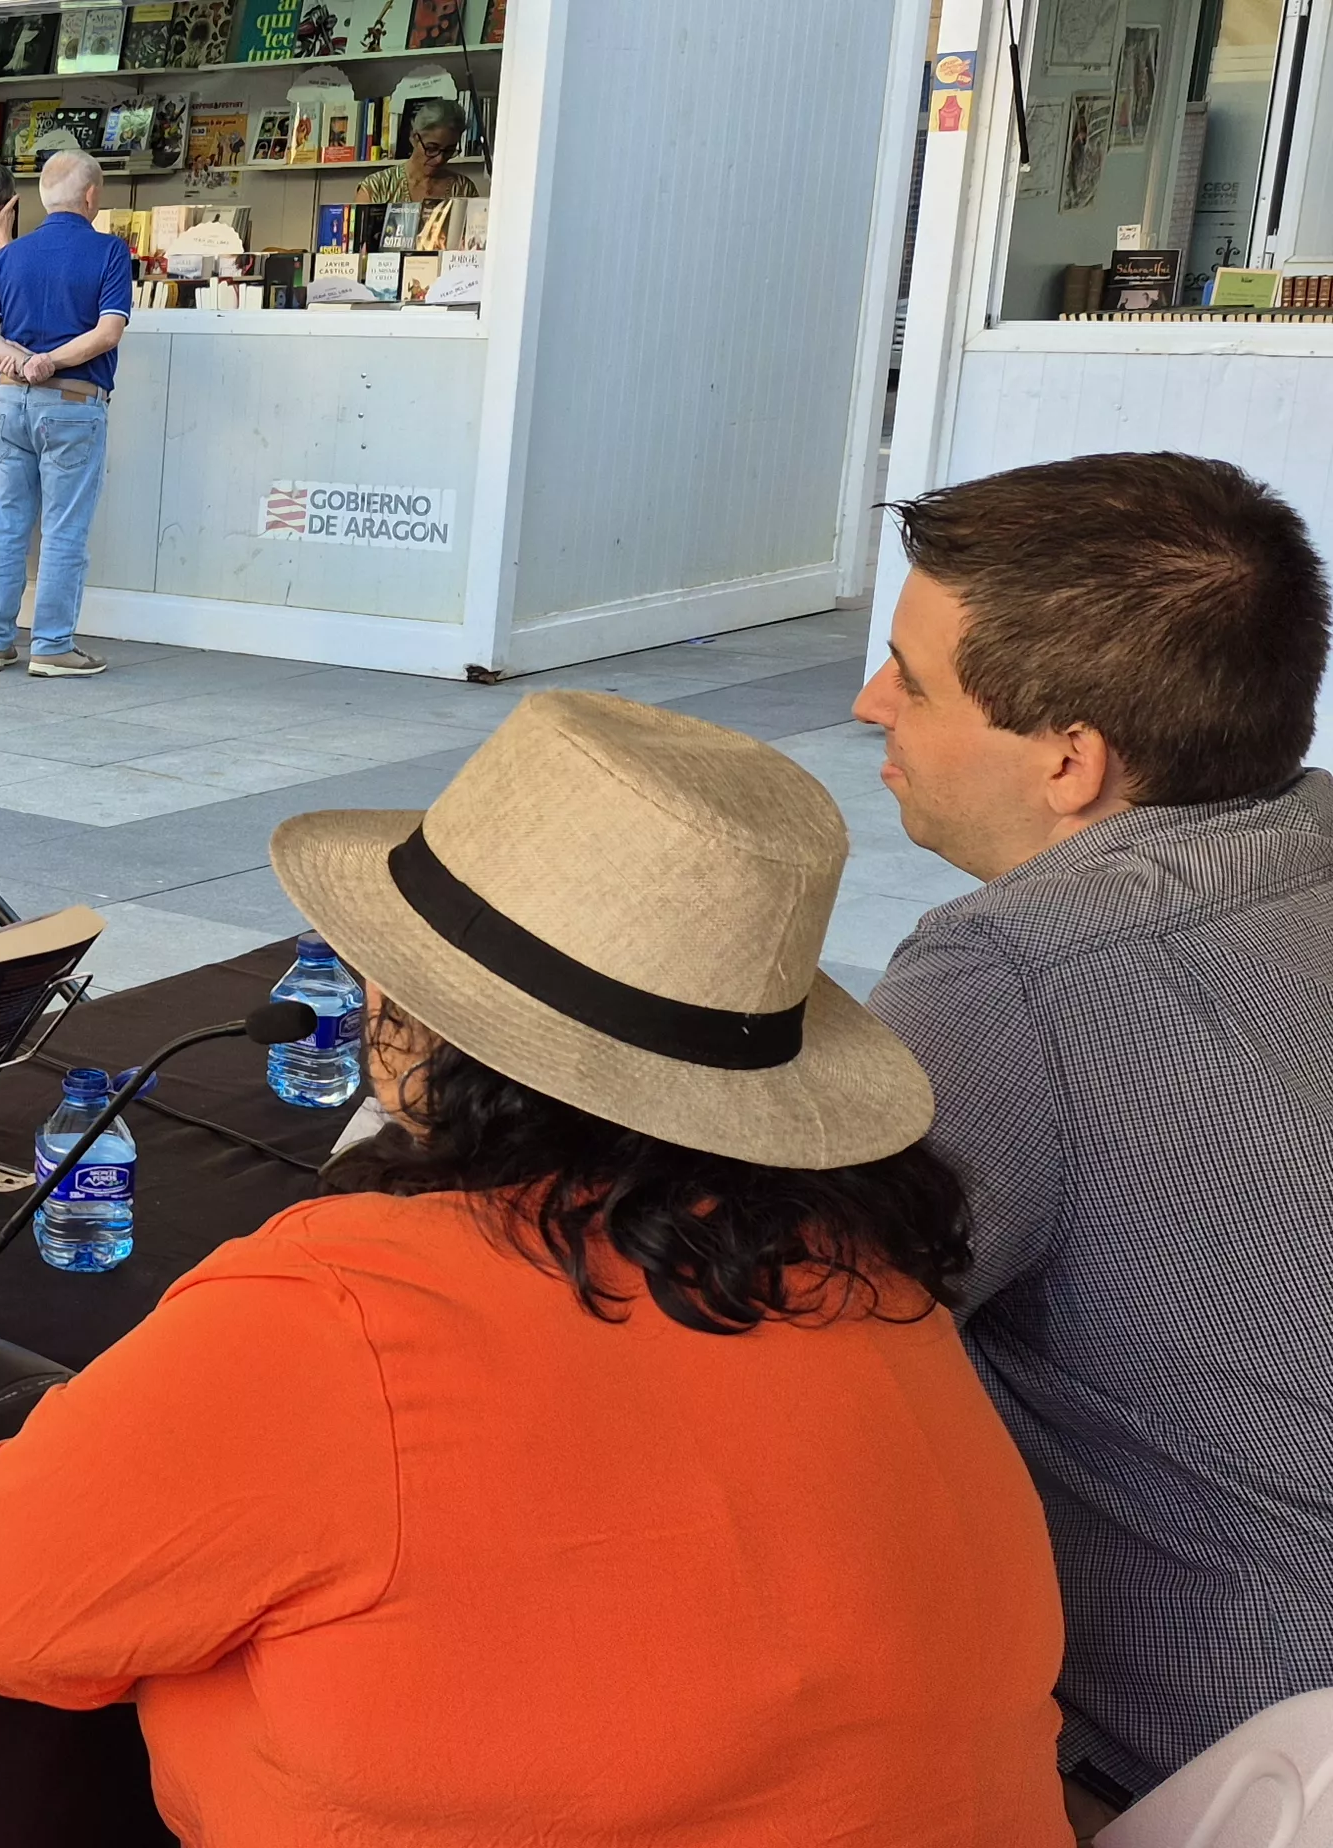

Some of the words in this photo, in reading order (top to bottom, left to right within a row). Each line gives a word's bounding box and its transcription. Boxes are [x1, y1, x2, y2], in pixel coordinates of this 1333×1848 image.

[256, 13, 293, 36] qui
[265, 28, 294, 48] tec
[309, 488, 432, 517] GOBIERNO
[308, 514, 338, 536] DE
[344, 516, 448, 544] ARAGON
